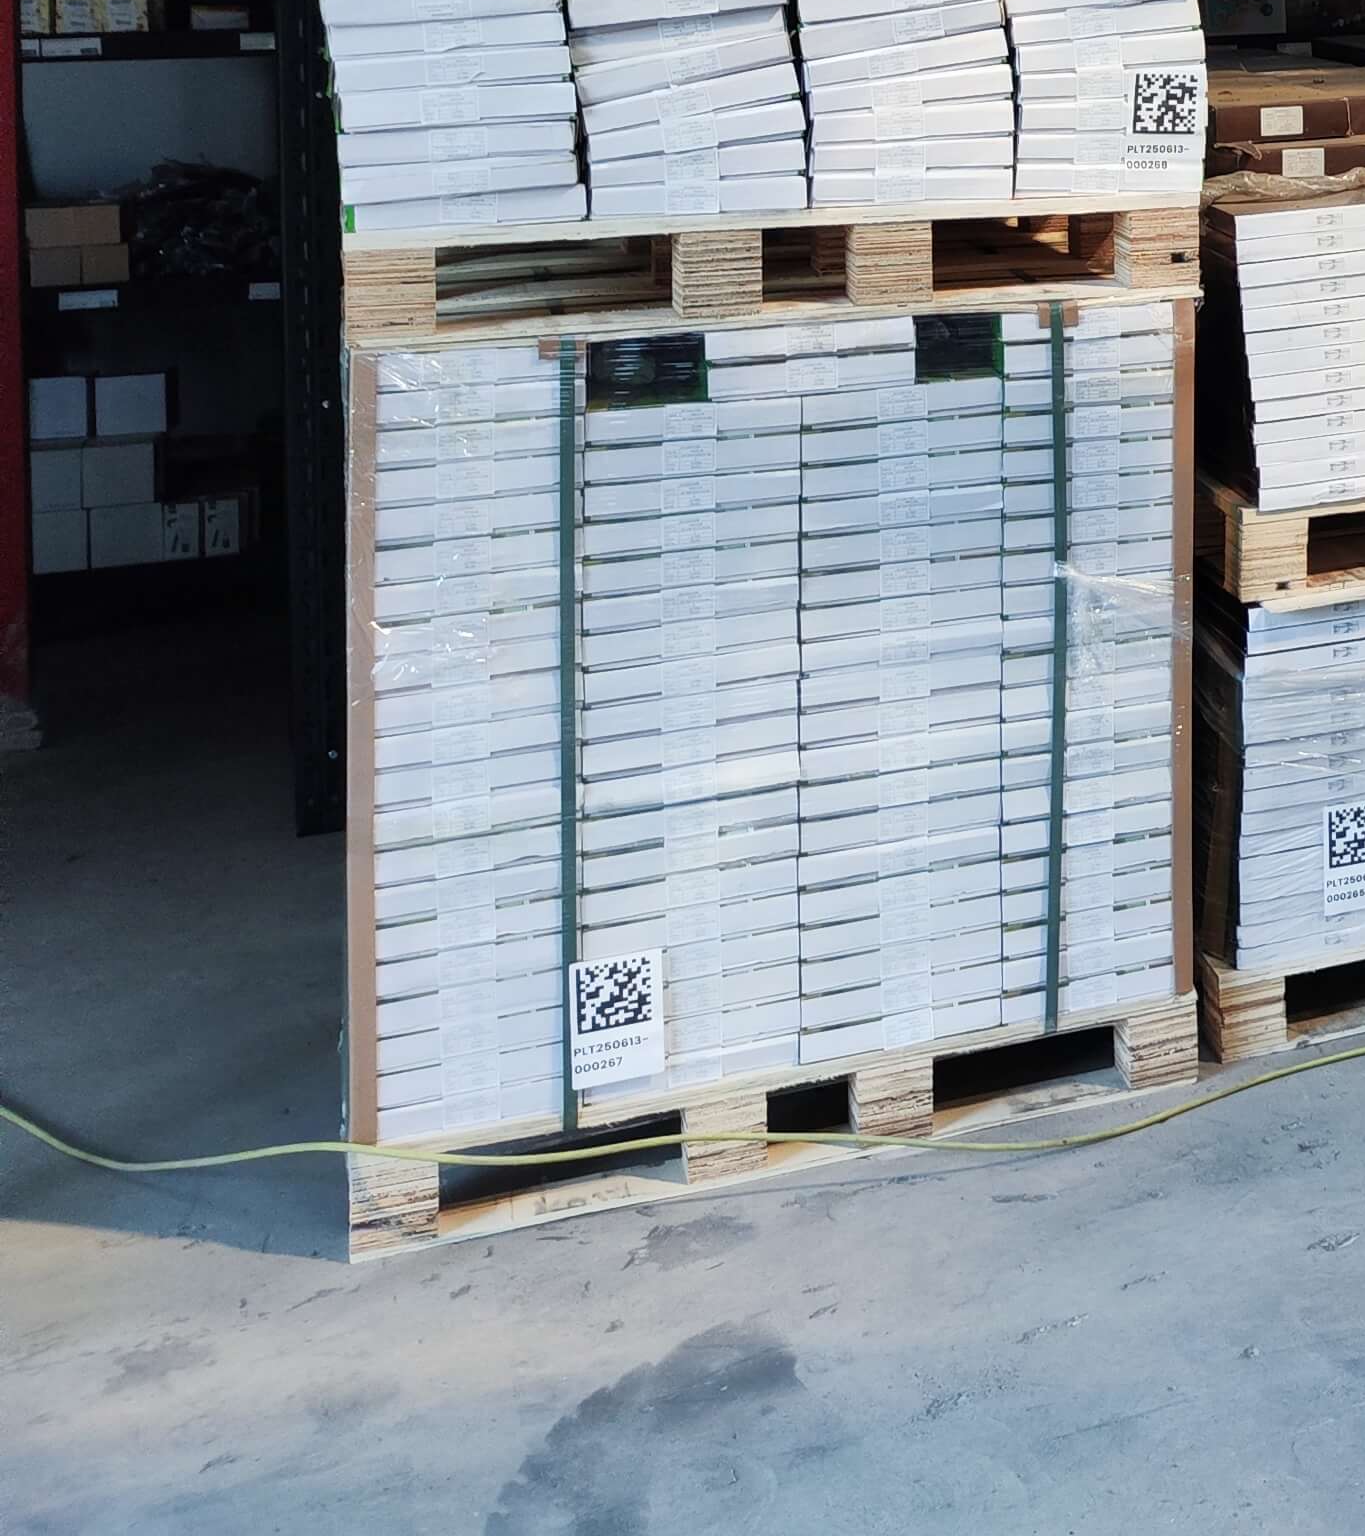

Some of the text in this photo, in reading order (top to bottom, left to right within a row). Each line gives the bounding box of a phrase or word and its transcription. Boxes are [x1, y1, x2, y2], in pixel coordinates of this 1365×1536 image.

[1127, 145, 1190, 153] PLT250613-
[574, 1035, 648, 1057] PLT250613-
[574, 1056, 623, 1074] 000267
